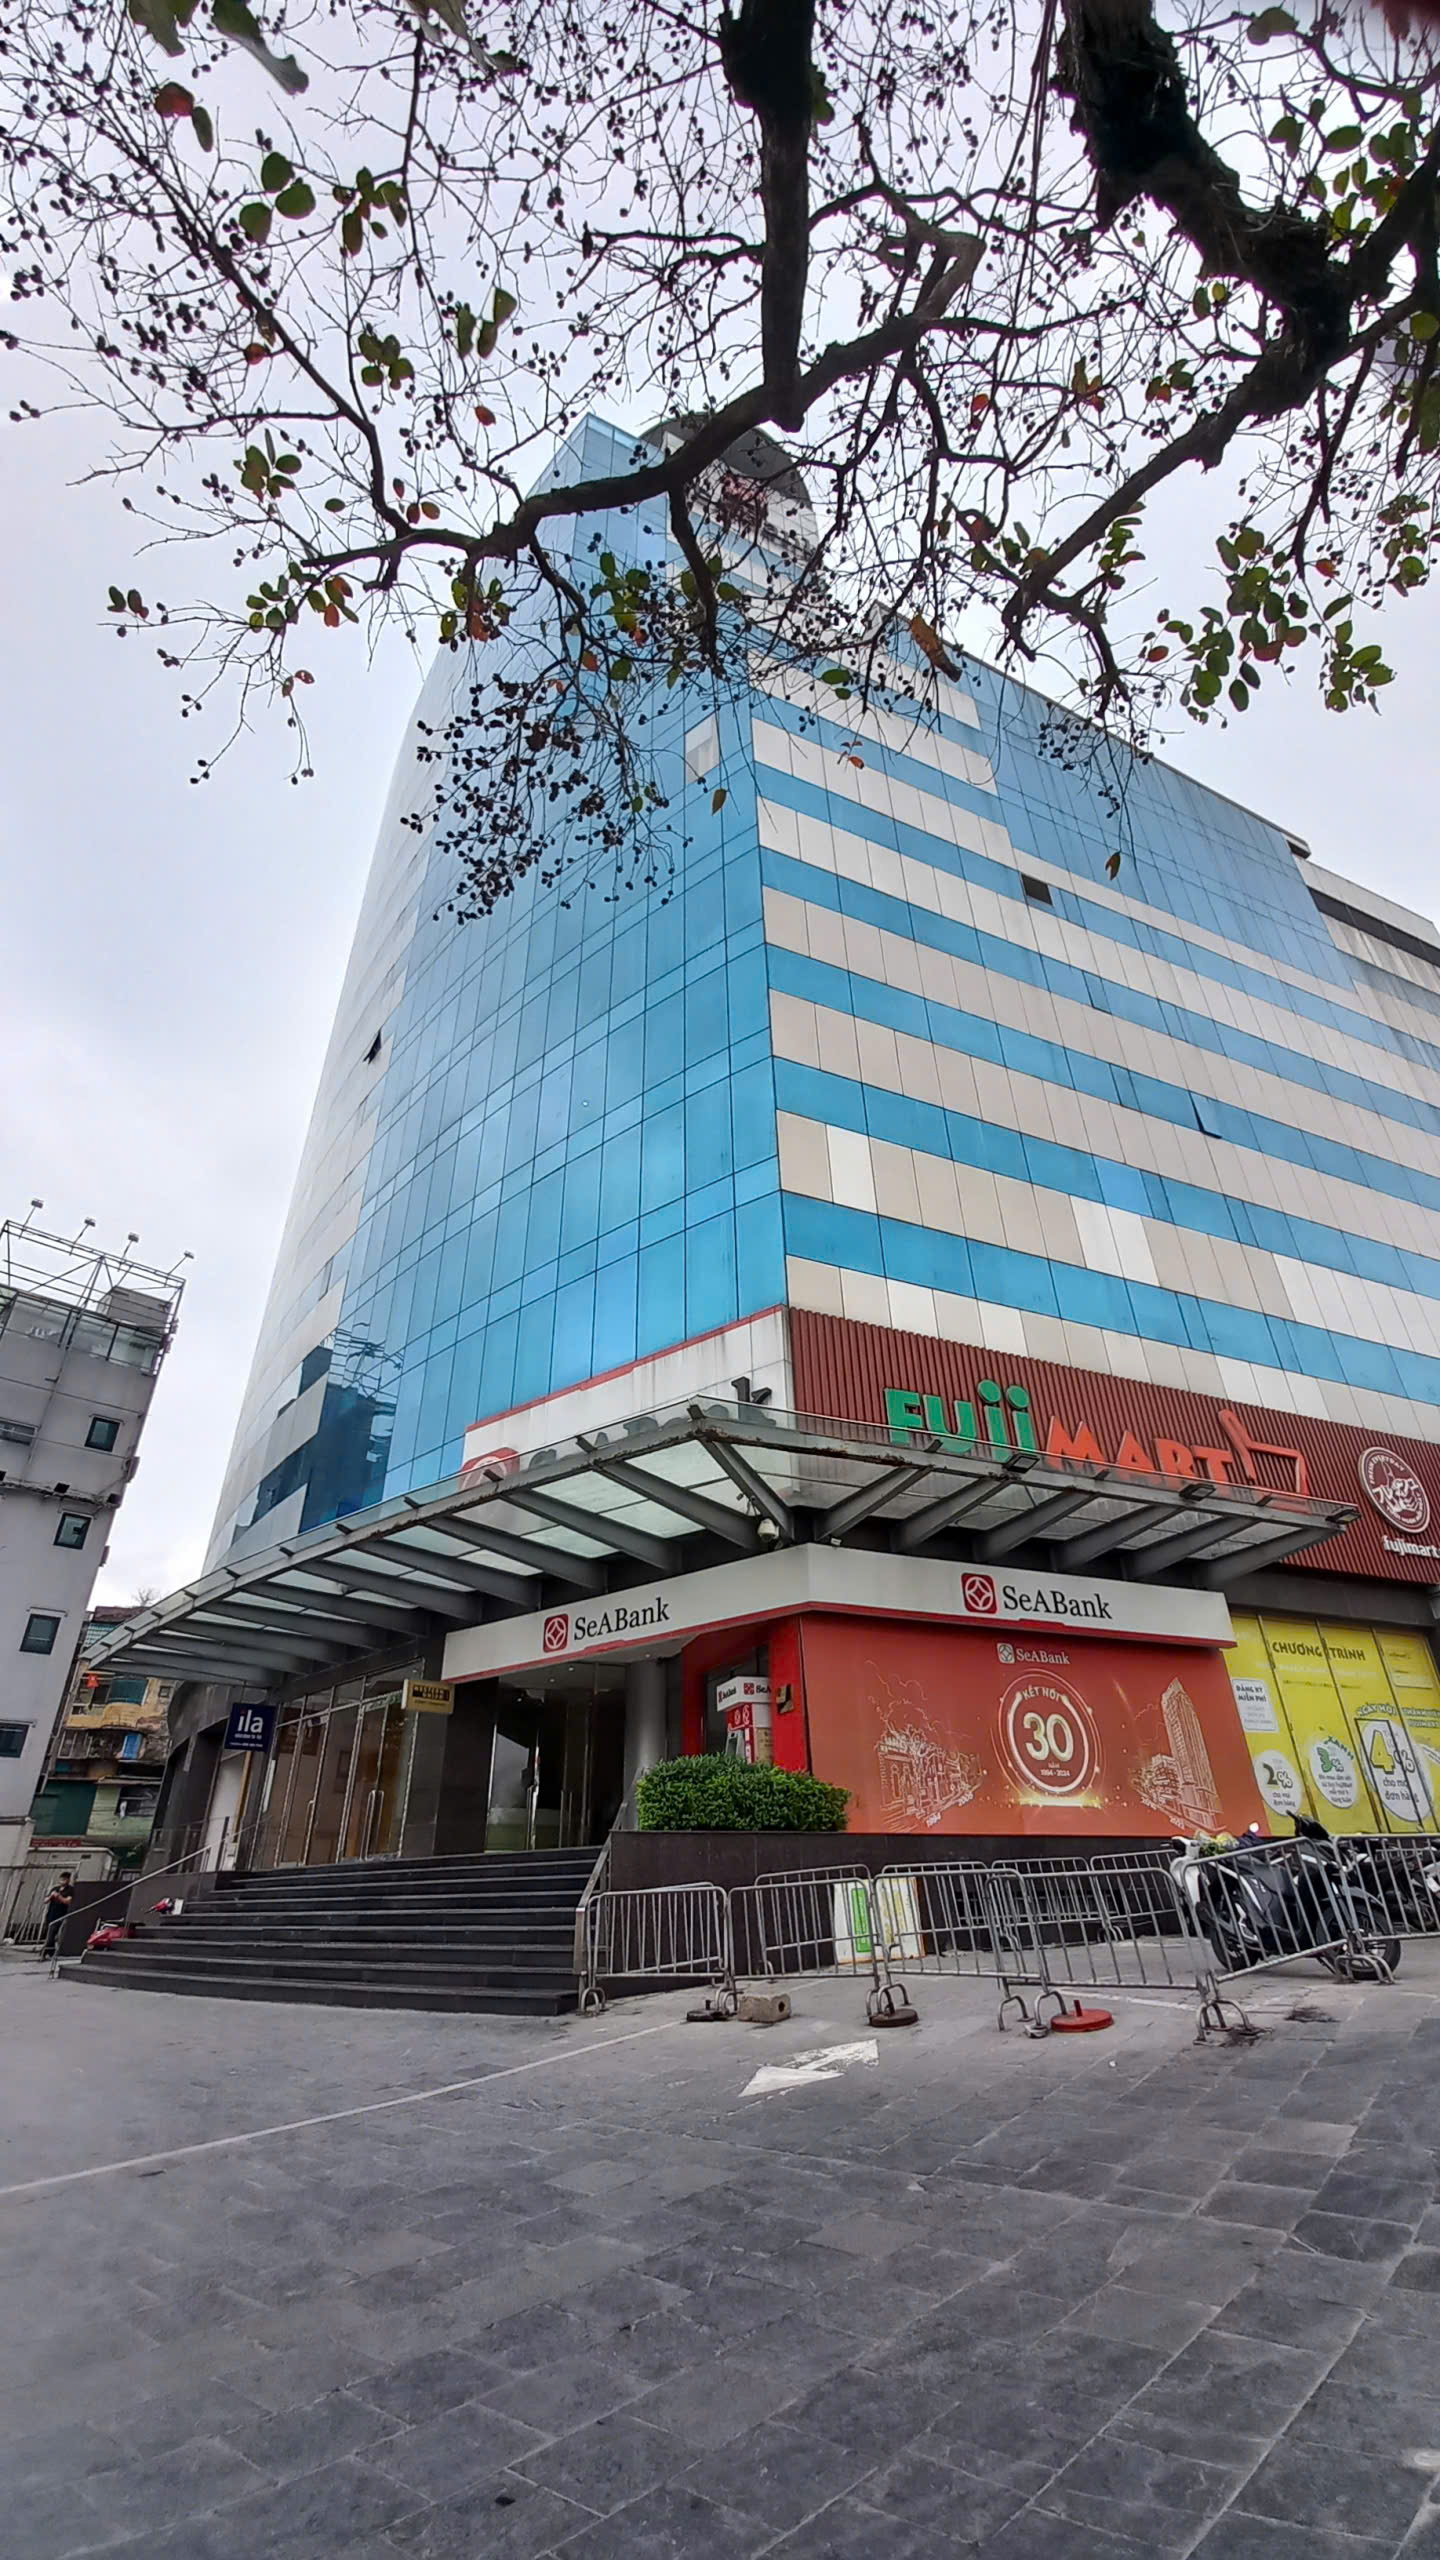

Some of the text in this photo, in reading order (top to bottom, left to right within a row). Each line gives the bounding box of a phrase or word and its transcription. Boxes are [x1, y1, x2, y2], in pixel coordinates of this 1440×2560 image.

[1046, 1415, 1234, 1490] MART
[574, 1596, 670, 1641] SeABank
[1002, 1585, 1113, 1620] SeABank
[1016, 1648, 1070, 1665] SeABank
[237, 1708, 264, 1733] ila
[1023, 1712, 1074, 1762] 30
[1263, 1763, 1294, 1789] 2%
